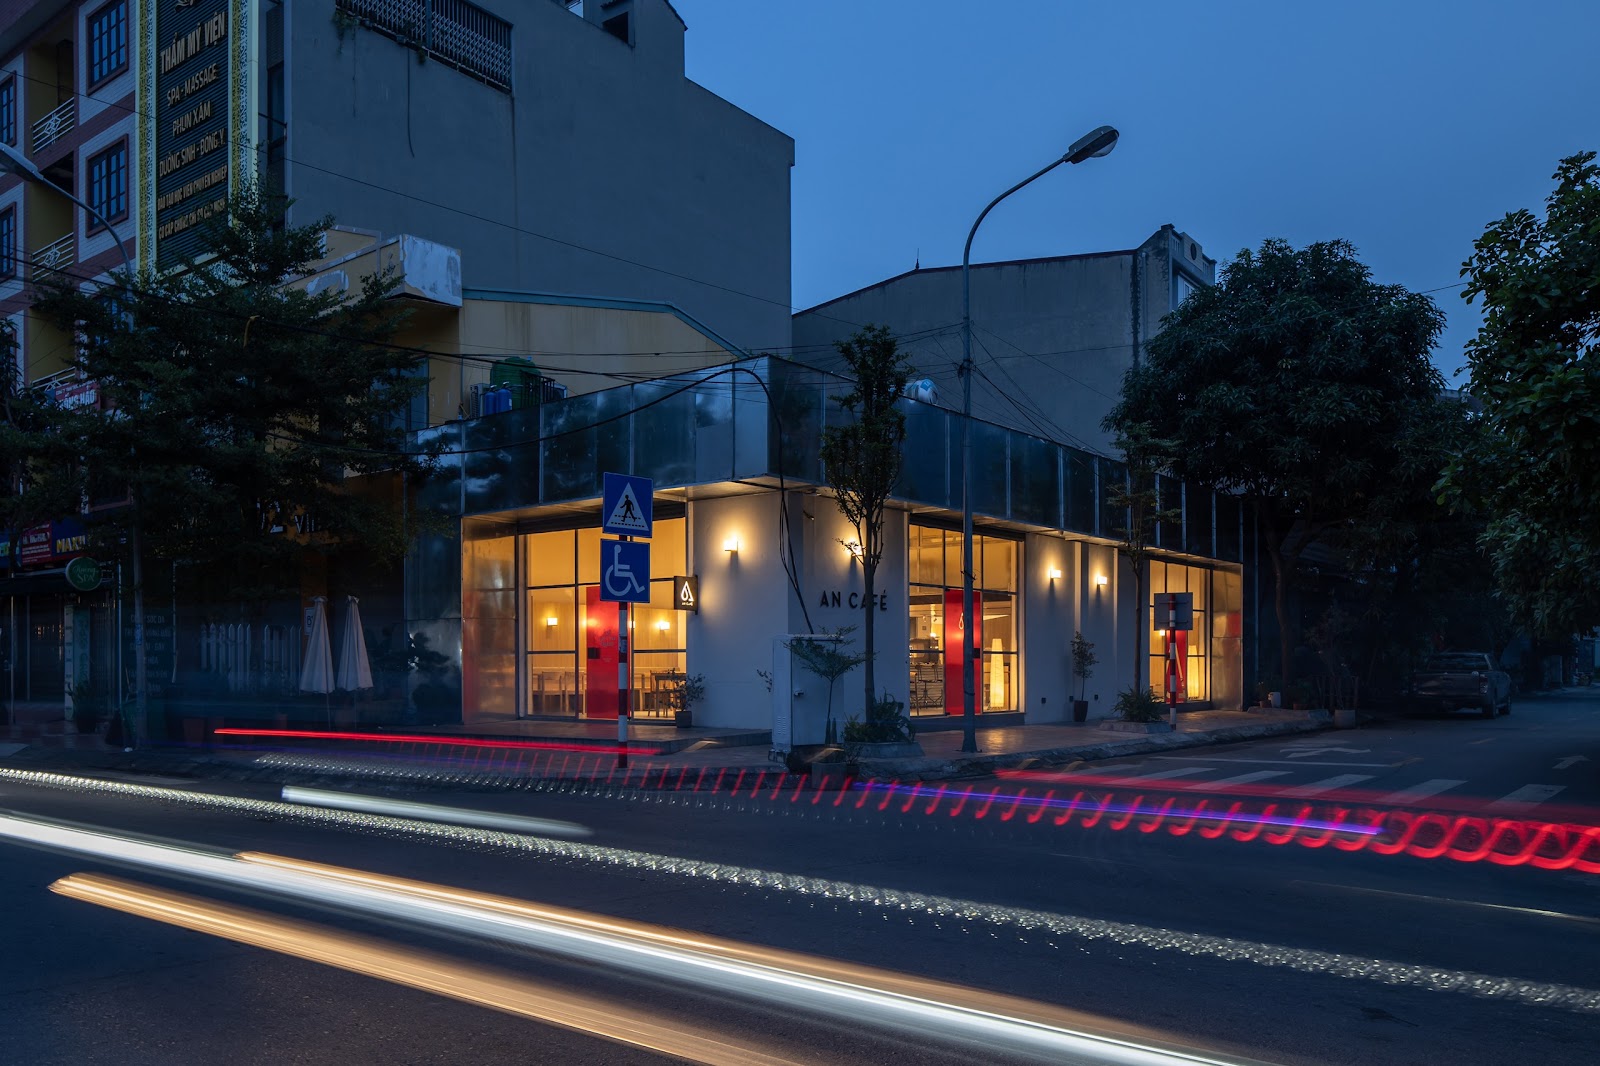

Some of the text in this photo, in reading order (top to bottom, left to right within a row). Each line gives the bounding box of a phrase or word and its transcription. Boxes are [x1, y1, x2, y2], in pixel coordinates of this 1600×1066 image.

[204, 11, 226, 47] VIỆN
[166, 86, 181, 107] SPA
[184, 63, 219, 97] MASSAGE
[172, 112, 193, 137] PHUN
[181, 143, 196, 166] SINH
[77, 573, 95, 584] SPA
[820, 590, 841, 608] AN
